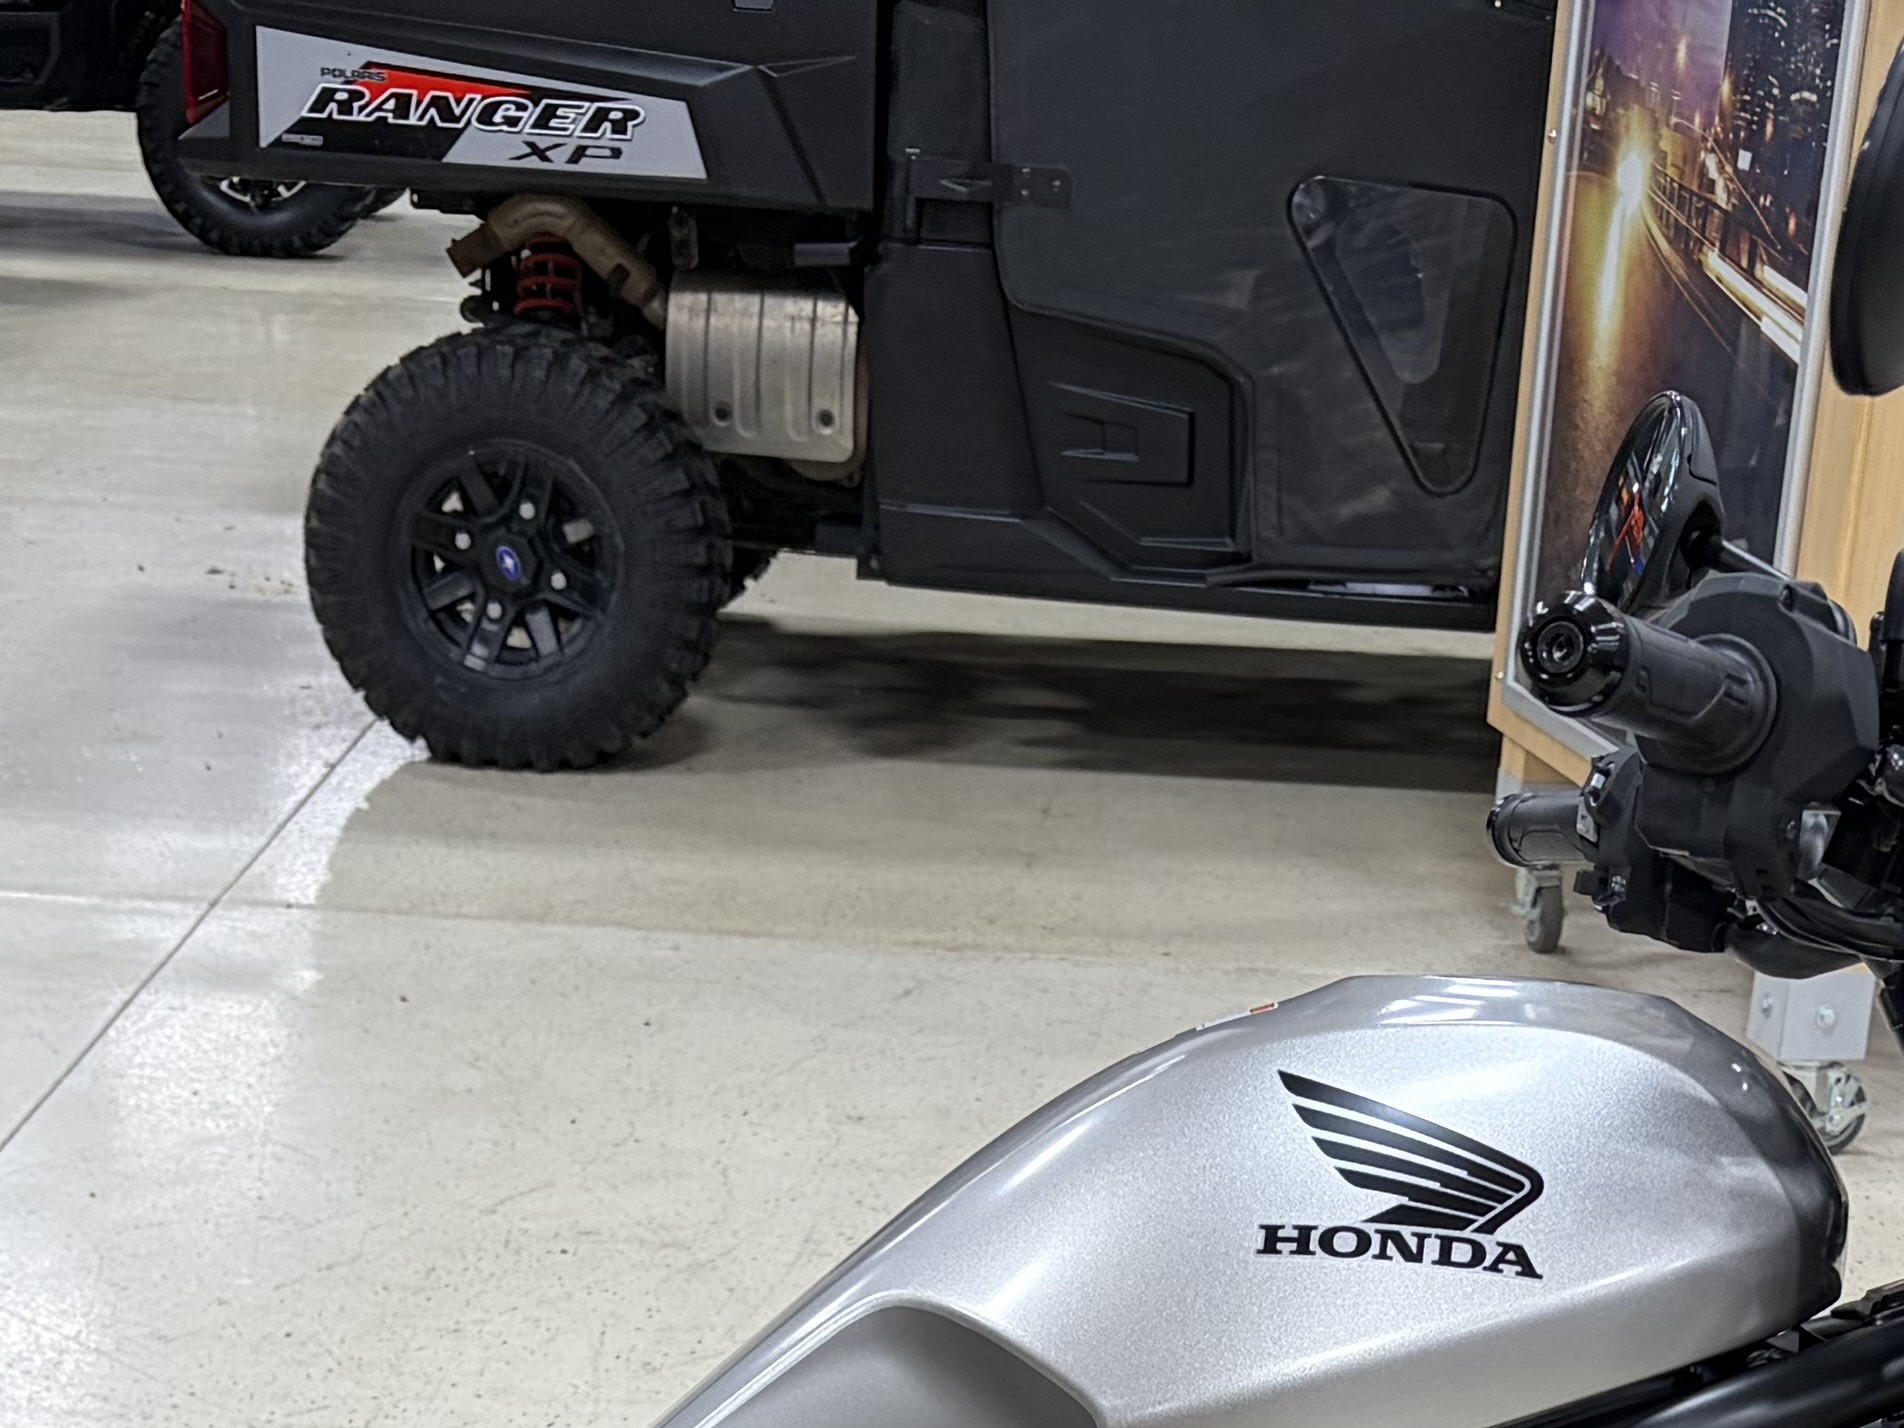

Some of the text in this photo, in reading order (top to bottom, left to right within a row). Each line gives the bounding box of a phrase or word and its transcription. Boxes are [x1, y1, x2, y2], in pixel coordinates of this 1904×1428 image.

[320, 67, 388, 82] POLARIS
[300, 83, 647, 141] RANGER
[508, 140, 624, 165] XP
[1256, 1223, 1544, 1280] HONDA
